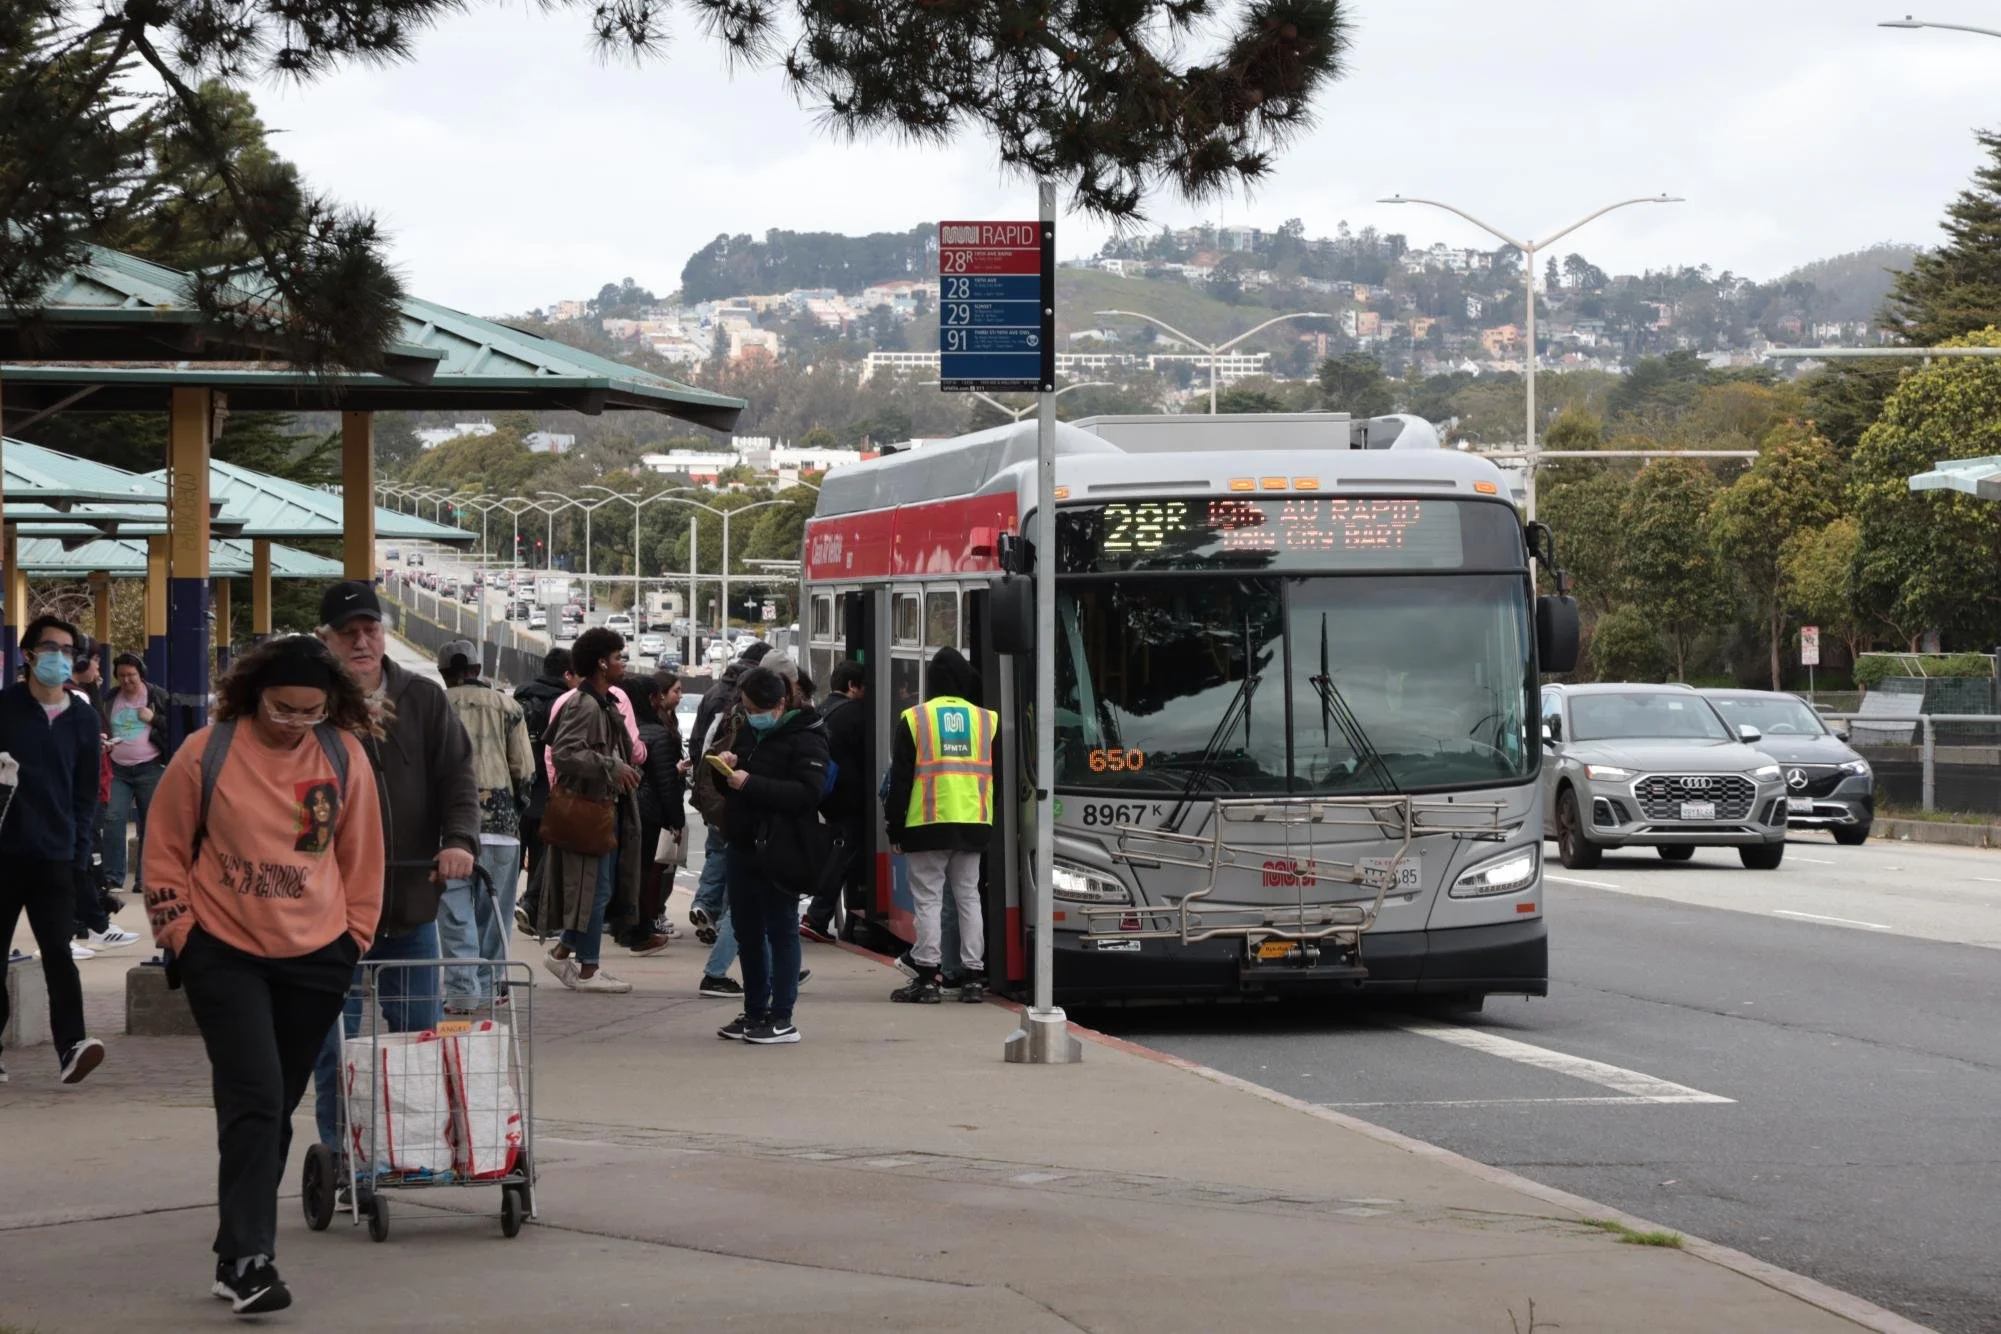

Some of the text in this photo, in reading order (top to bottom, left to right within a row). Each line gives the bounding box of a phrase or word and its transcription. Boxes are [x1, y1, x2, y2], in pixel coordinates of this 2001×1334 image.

[982, 226, 1033, 245] RAPID
[947, 278, 970, 299] 28
[947, 304, 970, 325] 29
[947, 330, 968, 351] 91
[1103, 502, 1187, 552] 28R
[943, 743, 968, 752] SFMTA
[1088, 749, 1144, 772] 650
[1082, 804, 1162, 826] 8967 K
